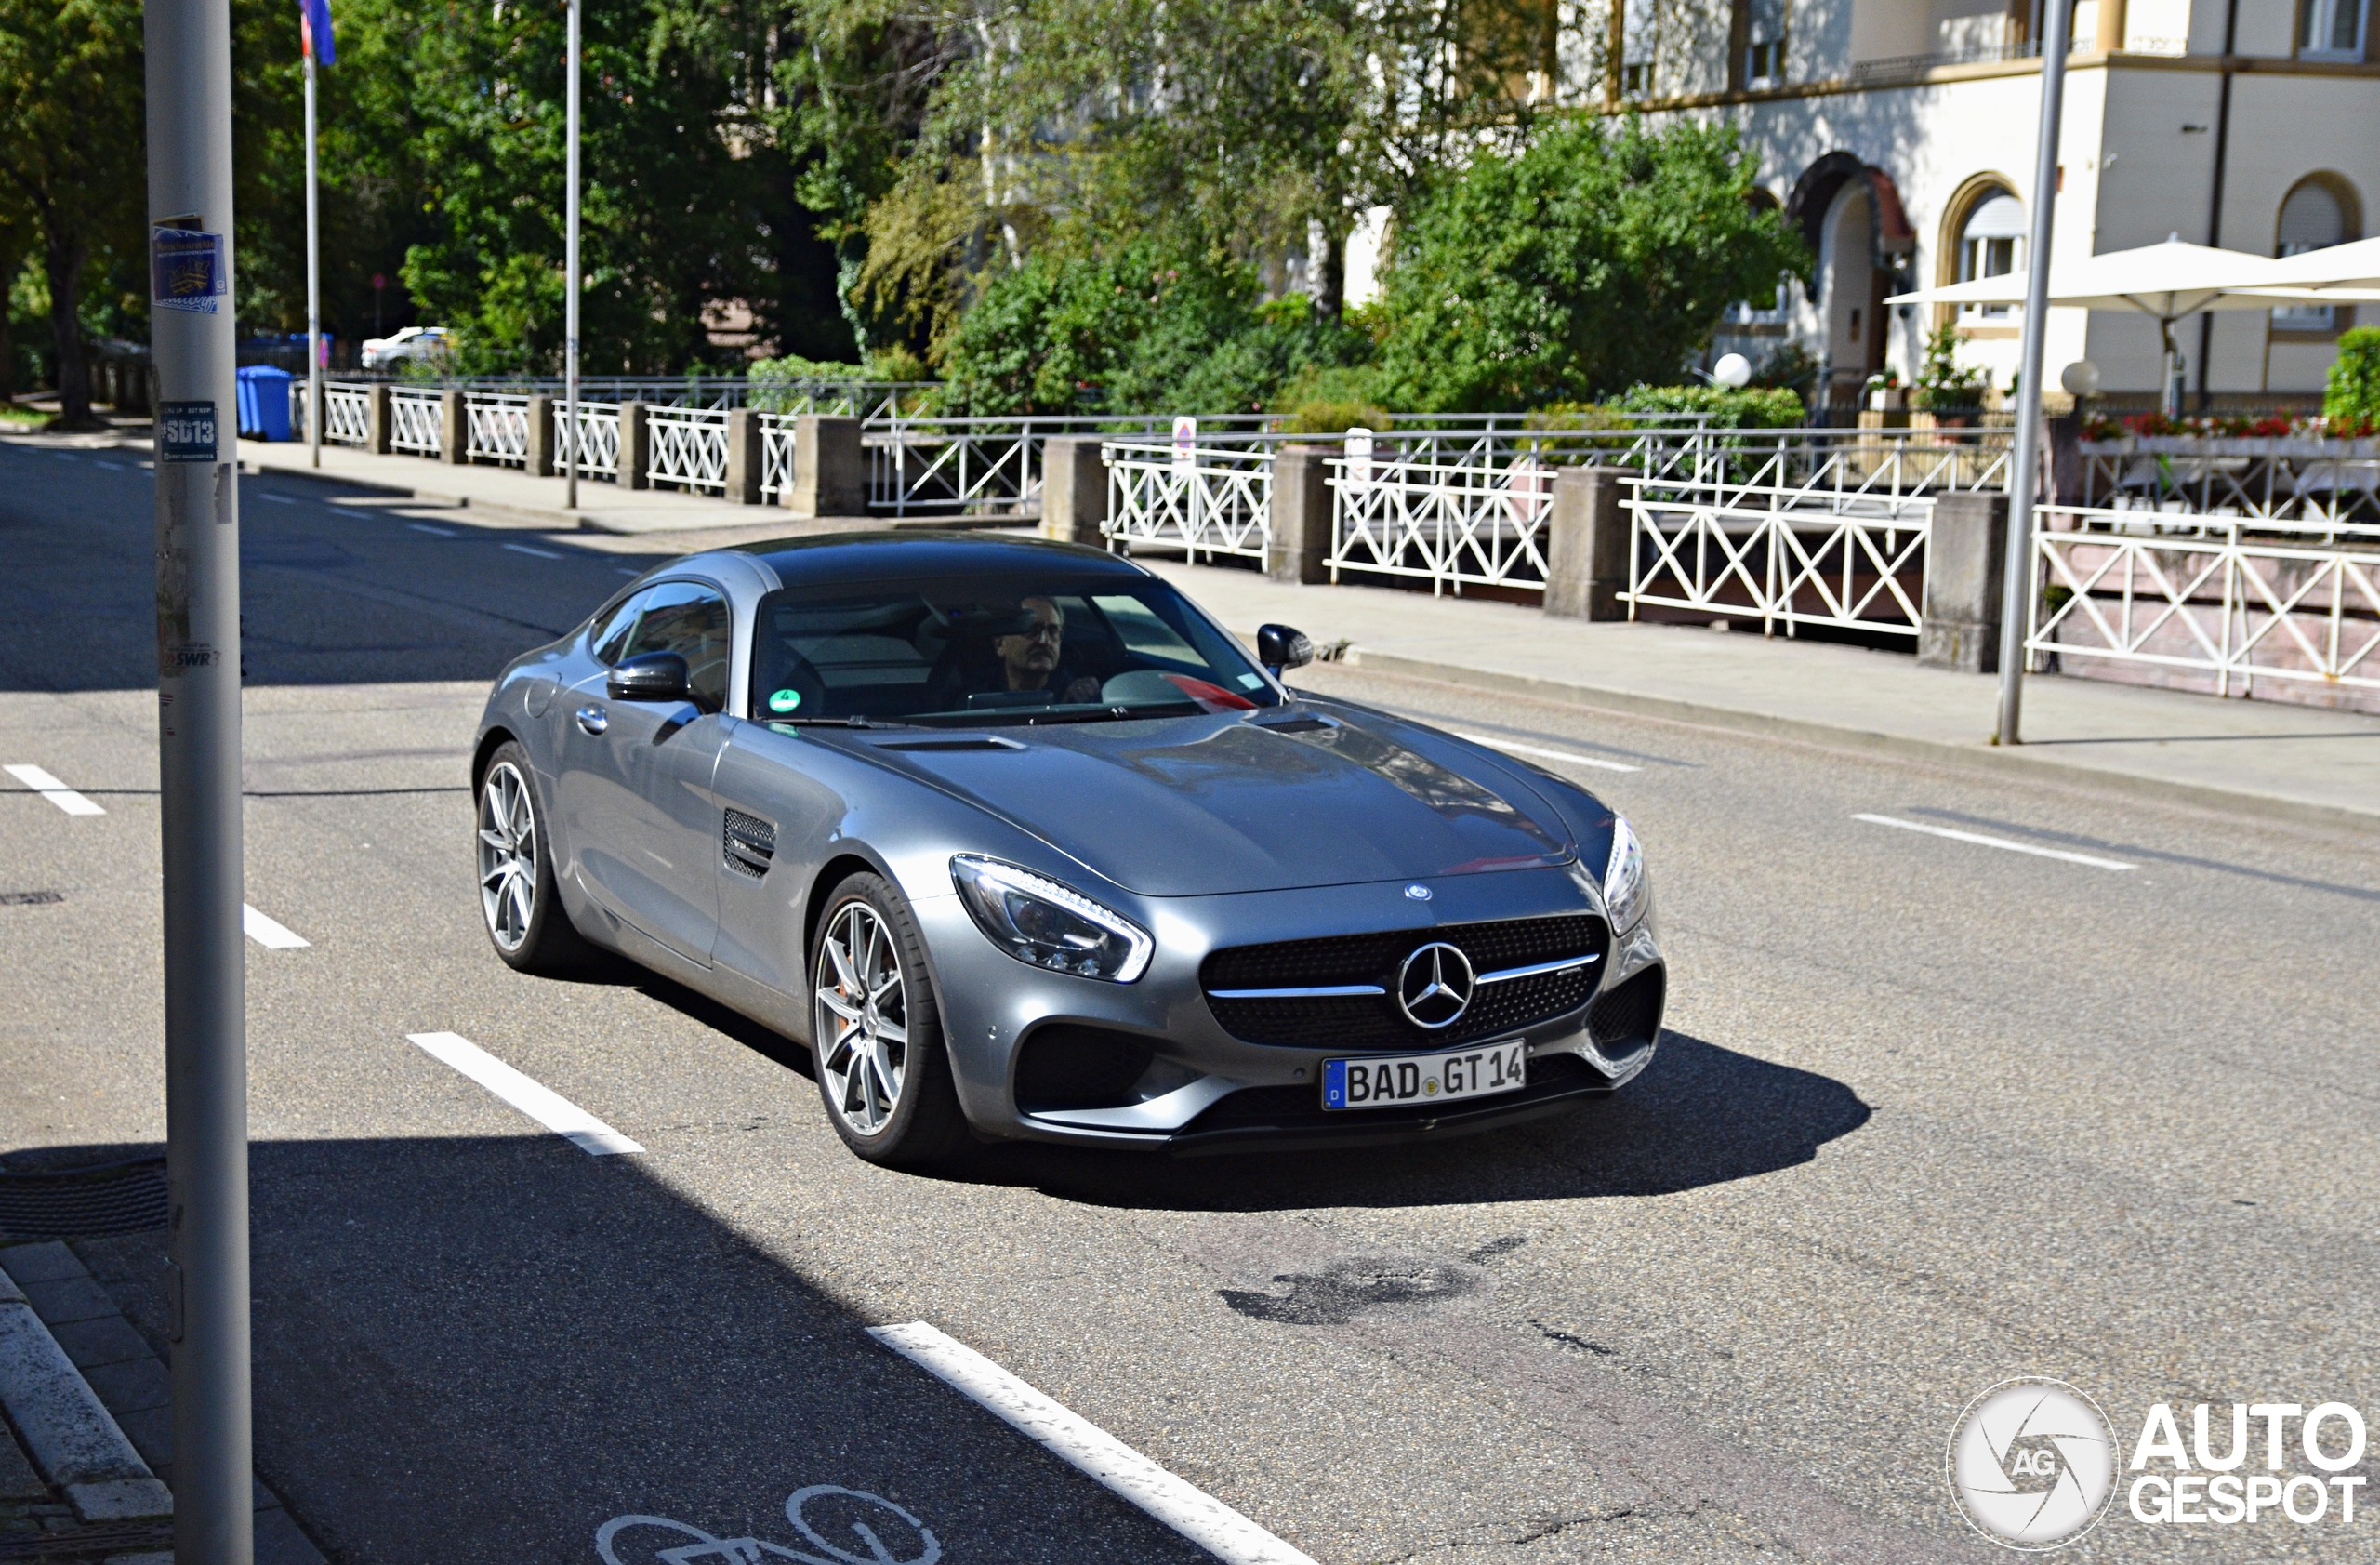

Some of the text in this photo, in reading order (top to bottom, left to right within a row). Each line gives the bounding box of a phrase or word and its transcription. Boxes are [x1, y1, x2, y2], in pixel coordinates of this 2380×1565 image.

[781, 689, 789, 700] 4
[1348, 1047, 1522, 1103] BAD GT 14
[1330, 1089, 1339, 1101] D
